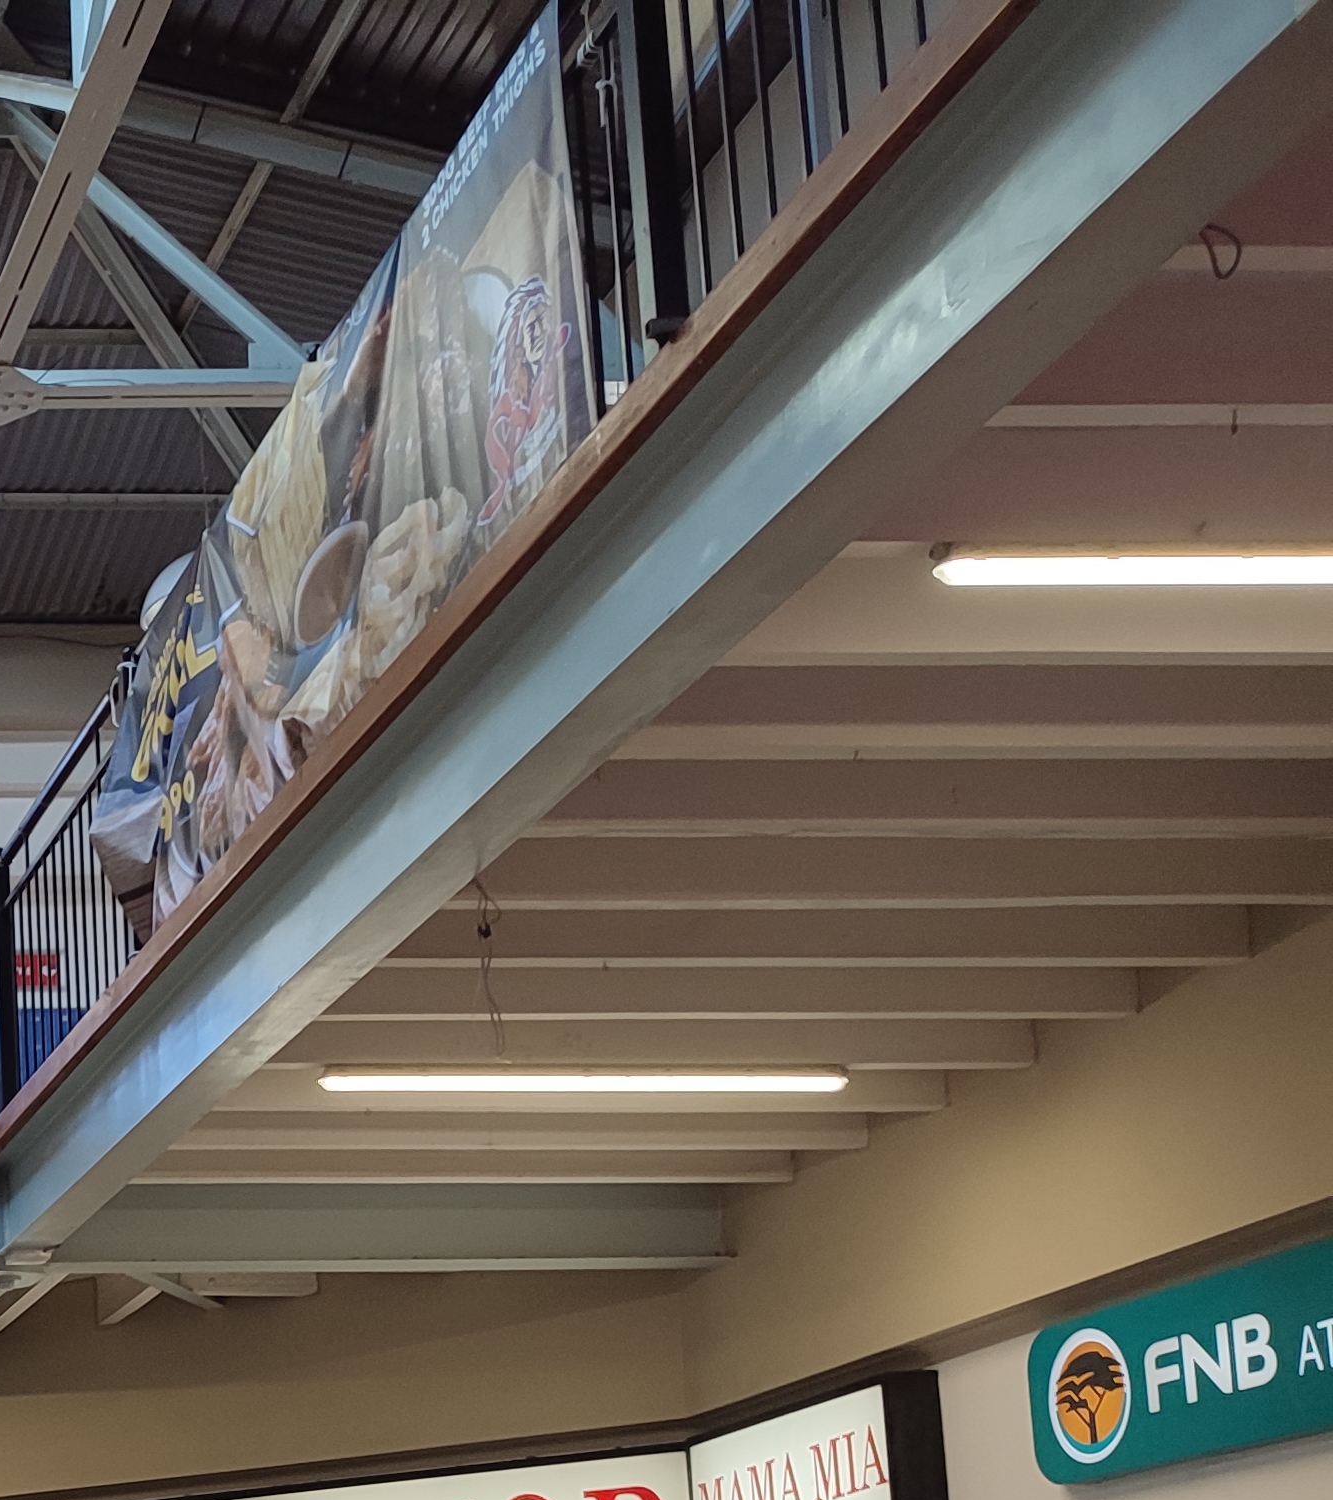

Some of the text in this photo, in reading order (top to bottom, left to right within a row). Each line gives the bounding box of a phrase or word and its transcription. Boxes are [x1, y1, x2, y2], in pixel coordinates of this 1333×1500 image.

[432, 127, 489, 230] CHICKEN
[491, 38, 547, 133] THIGHS
[1144, 1312, 1279, 1414] FNB
